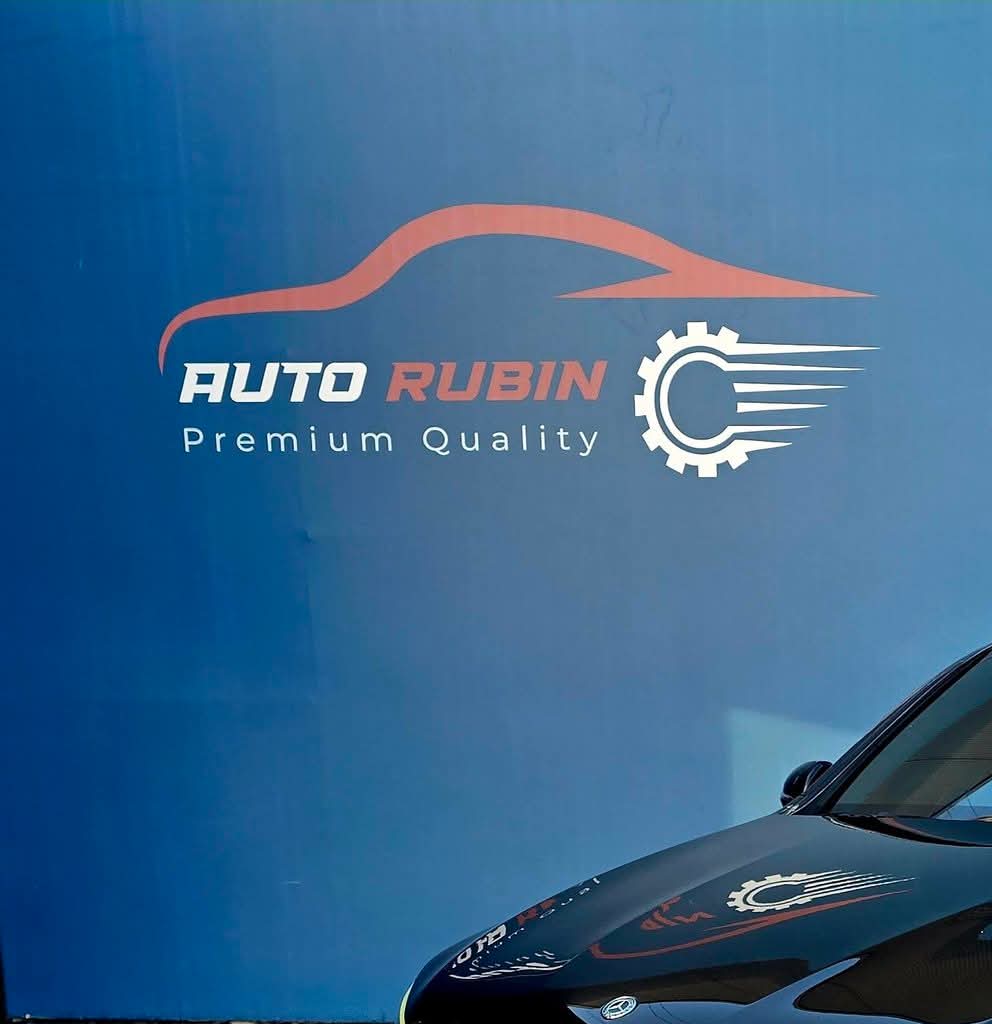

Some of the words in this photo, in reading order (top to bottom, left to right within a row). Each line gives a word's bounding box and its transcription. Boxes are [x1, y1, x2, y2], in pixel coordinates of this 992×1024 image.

[179, 362, 368, 403] AUTO
[386, 361, 607, 401] RUBIN
[183, 427, 392, 452] Premium
[422, 425, 598, 456] Quality
